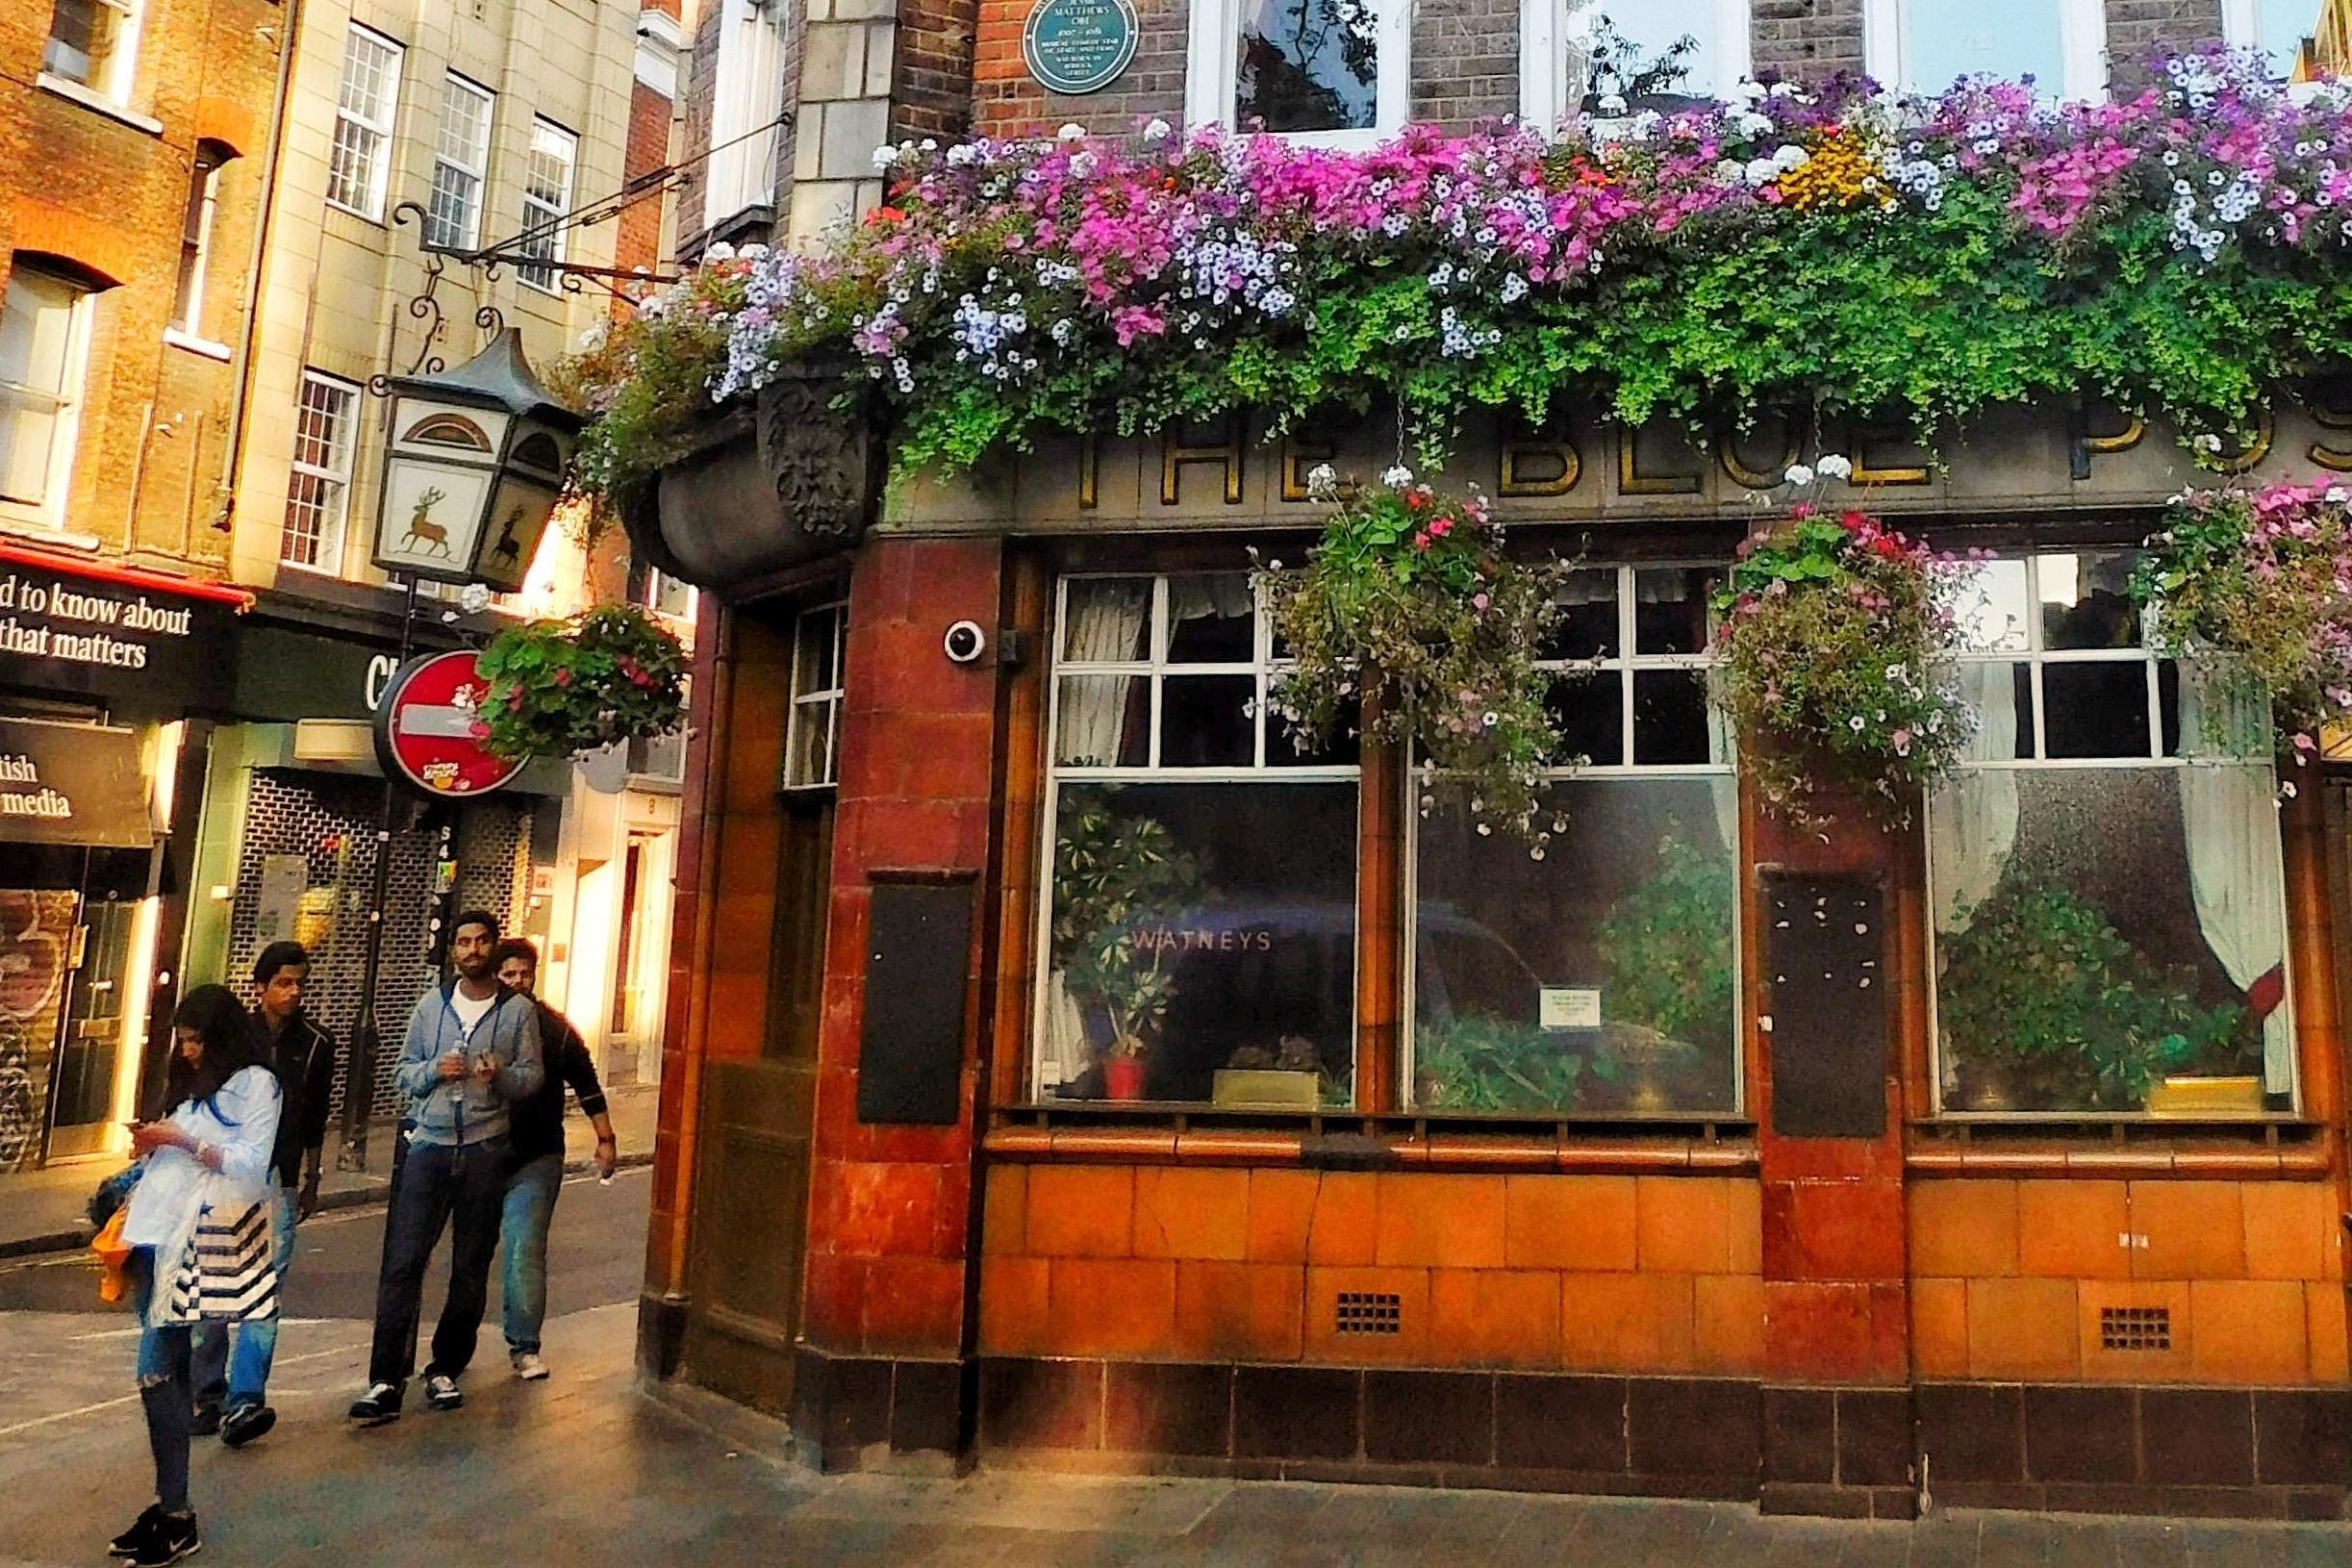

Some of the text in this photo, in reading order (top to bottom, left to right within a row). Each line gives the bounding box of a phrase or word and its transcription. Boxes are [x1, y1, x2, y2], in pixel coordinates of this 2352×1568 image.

[1054, 6, 1110, 16] MATTHEWS
[20, 580, 46, 613] to
[50, 582, 123, 624] know
[123, 596, 192, 636] about
[0, 617, 147, 669] that matters
[0, 788, 72, 818] media
[1130, 929, 1272, 951] WATNEYS
